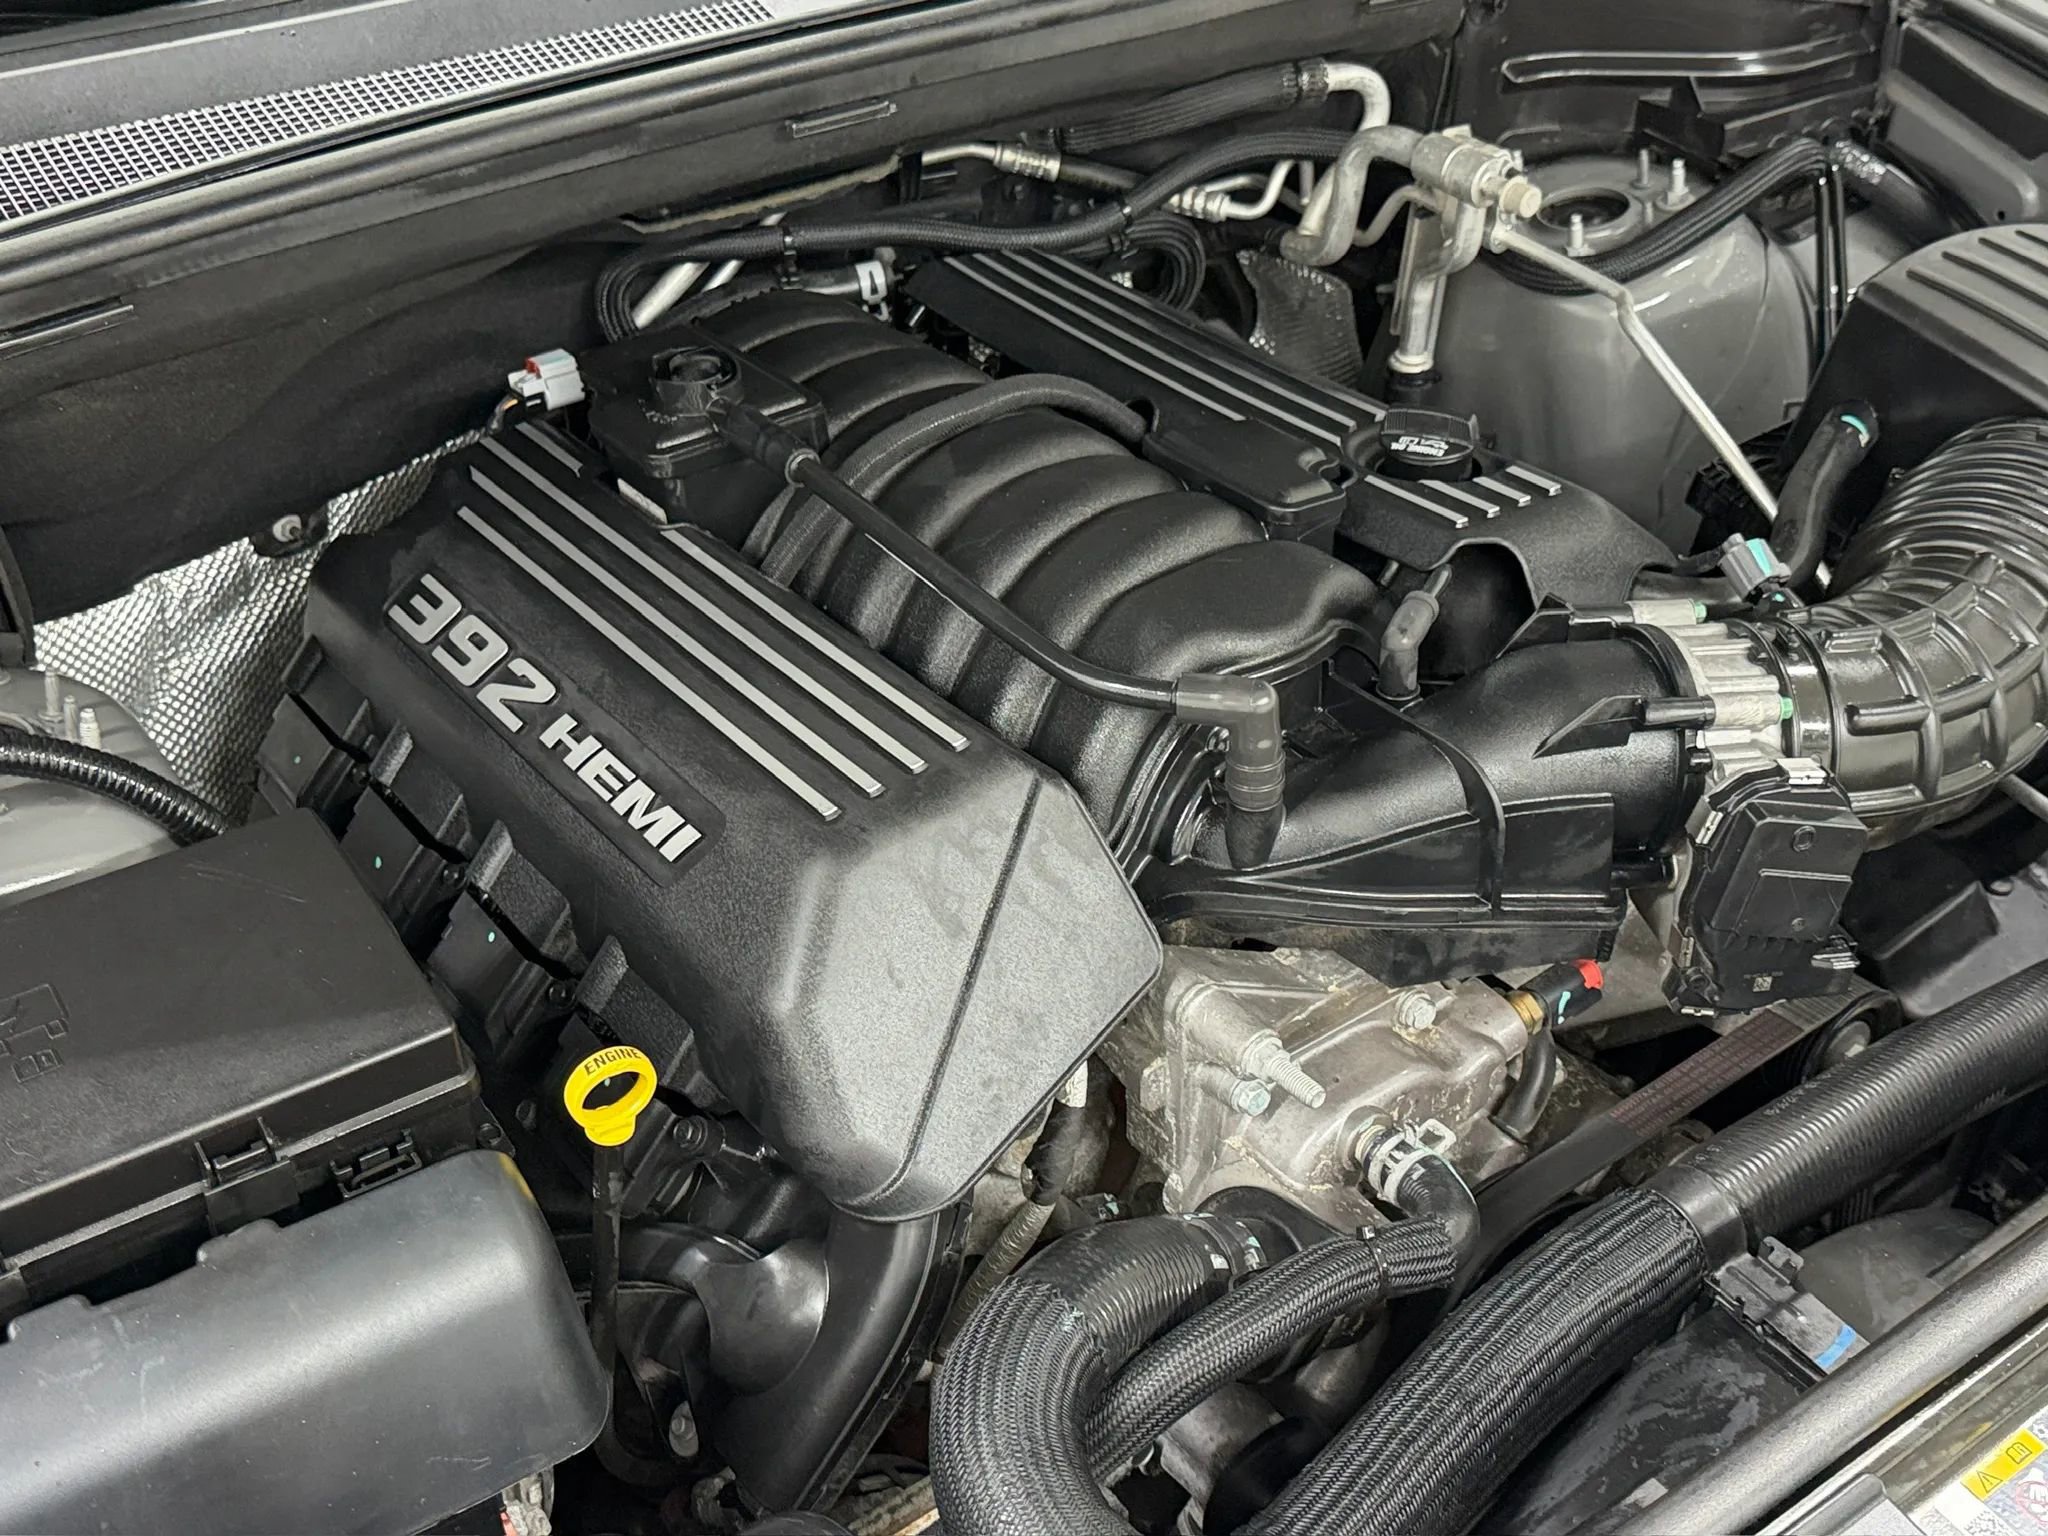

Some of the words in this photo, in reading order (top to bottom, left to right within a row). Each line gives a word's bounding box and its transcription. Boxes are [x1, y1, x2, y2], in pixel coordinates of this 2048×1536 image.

[388, 573, 557, 733] 392
[538, 713, 702, 863] HEMI
[583, 1048, 642, 1076] ENGINE
